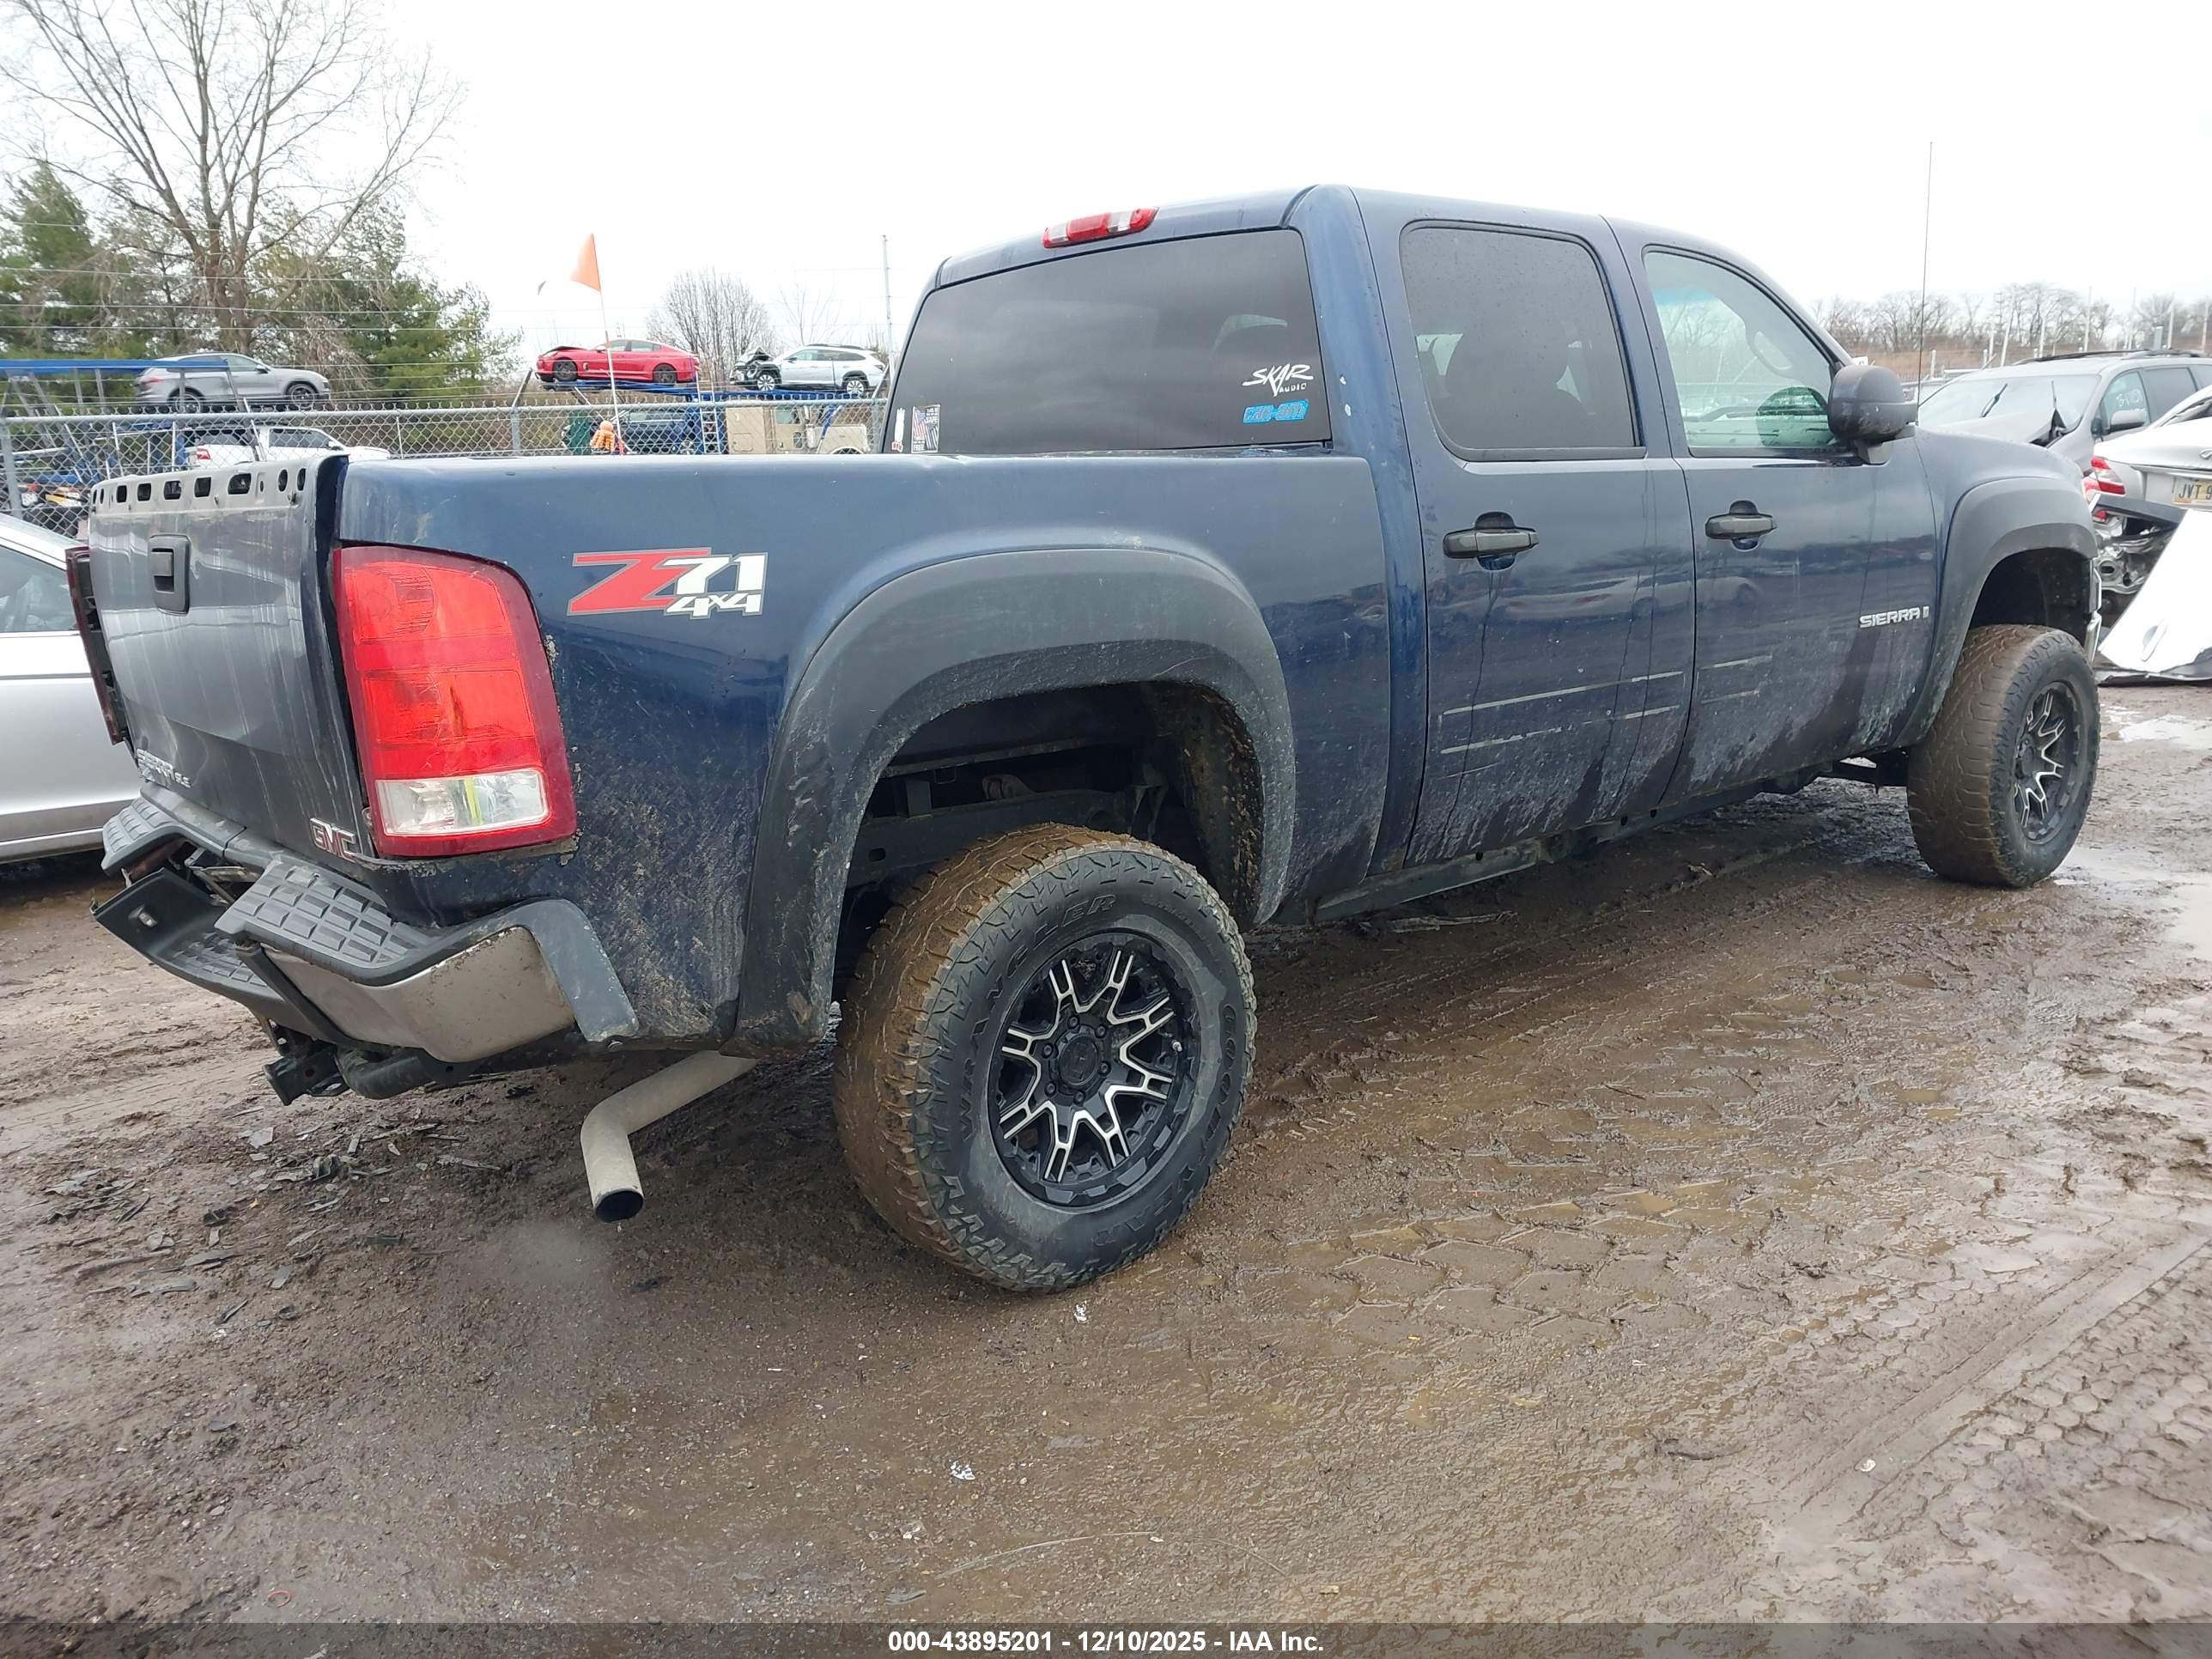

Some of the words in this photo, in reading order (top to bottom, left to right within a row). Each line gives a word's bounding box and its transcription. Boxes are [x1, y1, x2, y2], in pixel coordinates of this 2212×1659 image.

[1242, 363, 1314, 397] SKAR
[1279, 382, 1307, 393] AUDIO
[2179, 483, 2202, 499] JVT
[567, 547, 769, 616] Z71
[1860, 607, 1920, 629] SIERRA
[310, 817, 357, 864] GMC
[959, 894, 1116, 1141] WRANGLER
